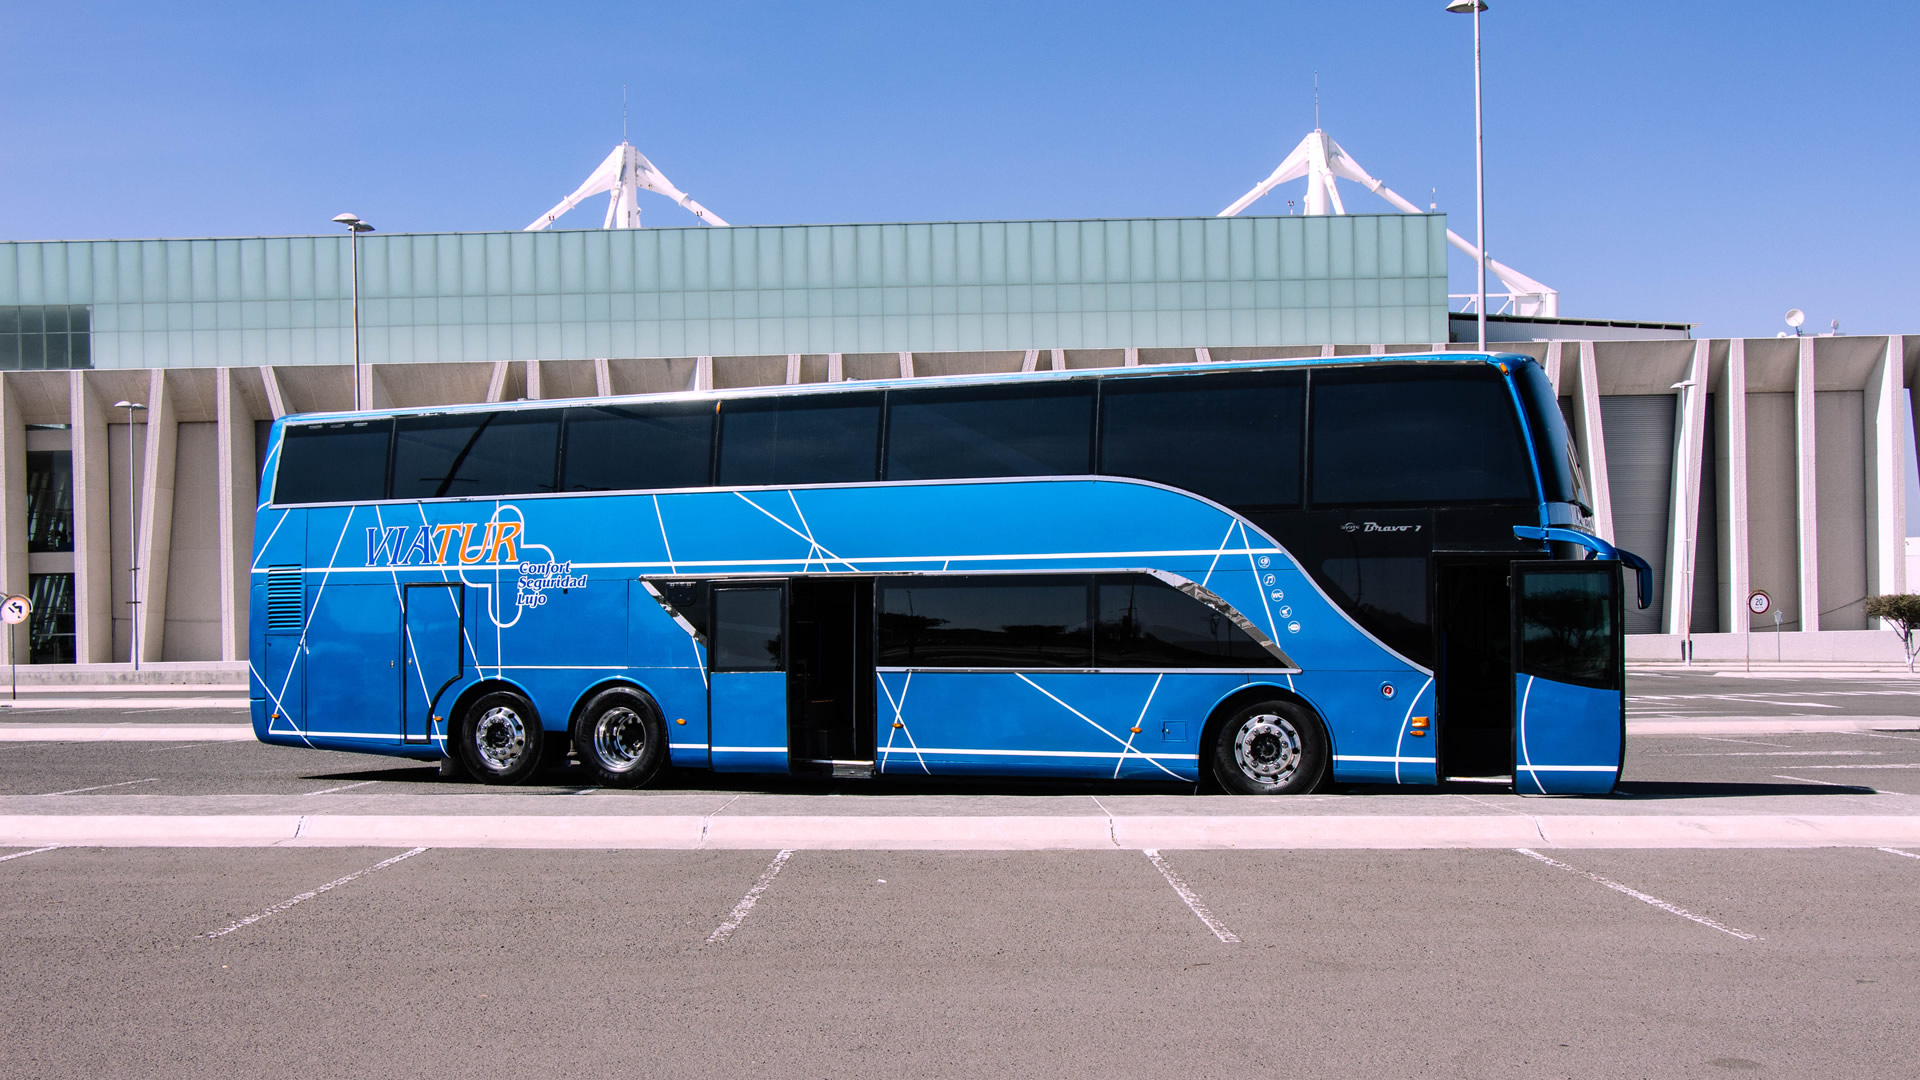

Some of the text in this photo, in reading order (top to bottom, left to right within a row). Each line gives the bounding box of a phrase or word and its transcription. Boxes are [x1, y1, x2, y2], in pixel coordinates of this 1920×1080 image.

[1363, 521, 1413, 532] Bravo
[365, 521, 523, 567] VIATUR
[518, 560, 572, 578] Confort
[516, 574, 588, 592] Seguridad
[515, 592, 548, 608] Lujo
[1755, 598, 1763, 606] 20
